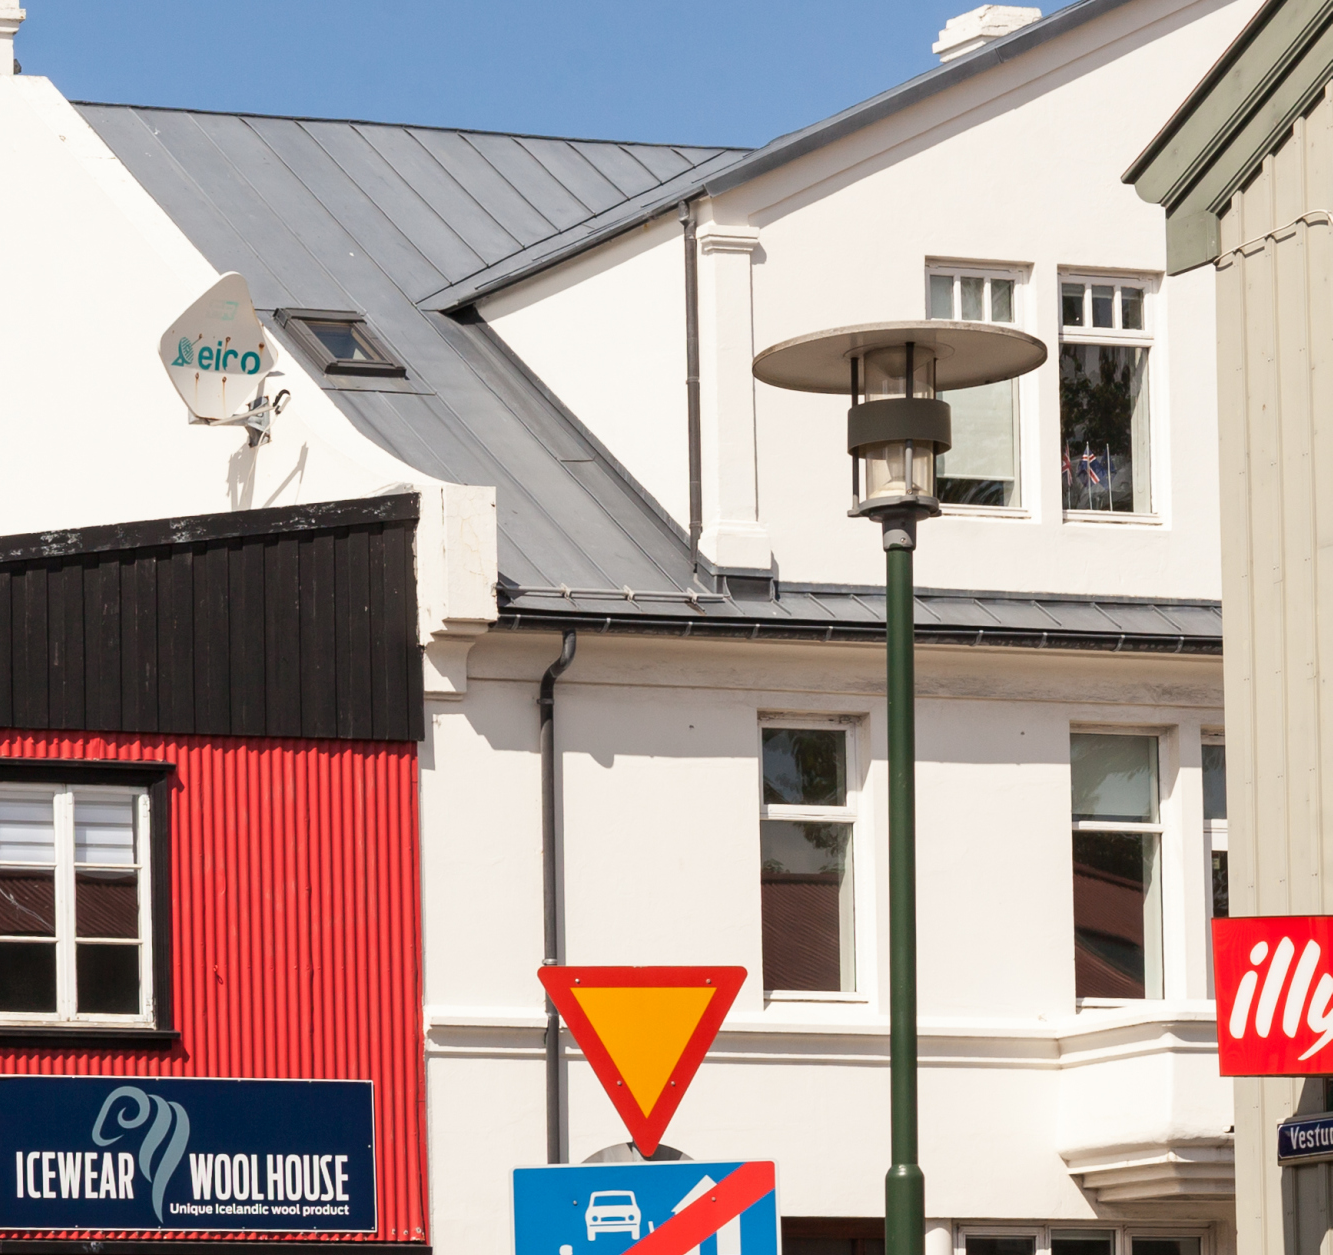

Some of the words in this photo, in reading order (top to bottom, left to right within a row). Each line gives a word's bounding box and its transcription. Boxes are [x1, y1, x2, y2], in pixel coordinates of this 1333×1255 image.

[1290, 1123, 1333, 1150] Vestu
[16, 1151, 135, 1199] ICEWEAR
[170, 1203, 213, 1216] Unique
[215, 1203, 269, 1215] Icelandic
[271, 1204, 301, 1215] wool
[303, 1204, 350, 1217] product
